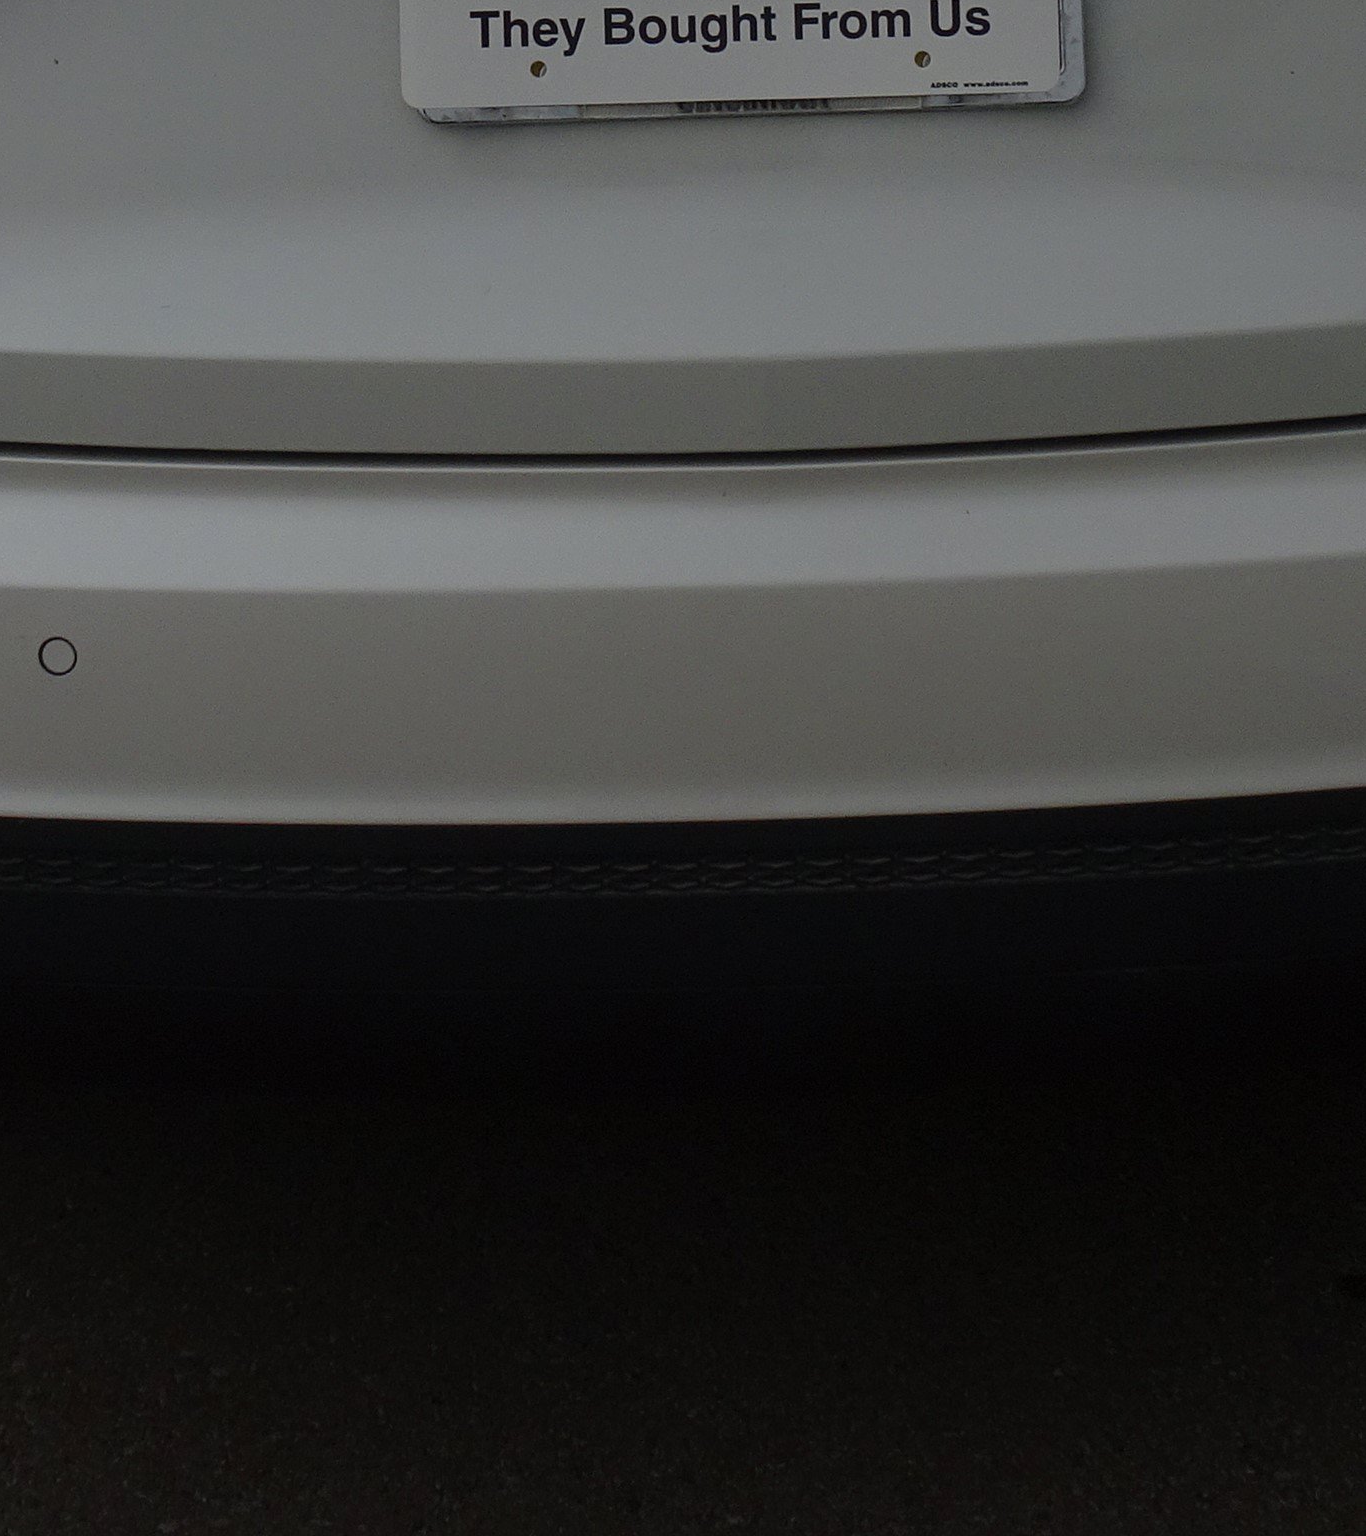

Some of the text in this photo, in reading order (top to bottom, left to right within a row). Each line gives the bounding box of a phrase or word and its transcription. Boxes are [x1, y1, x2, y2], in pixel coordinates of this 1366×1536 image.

[470, 0, 990, 56] They Bought From Us
